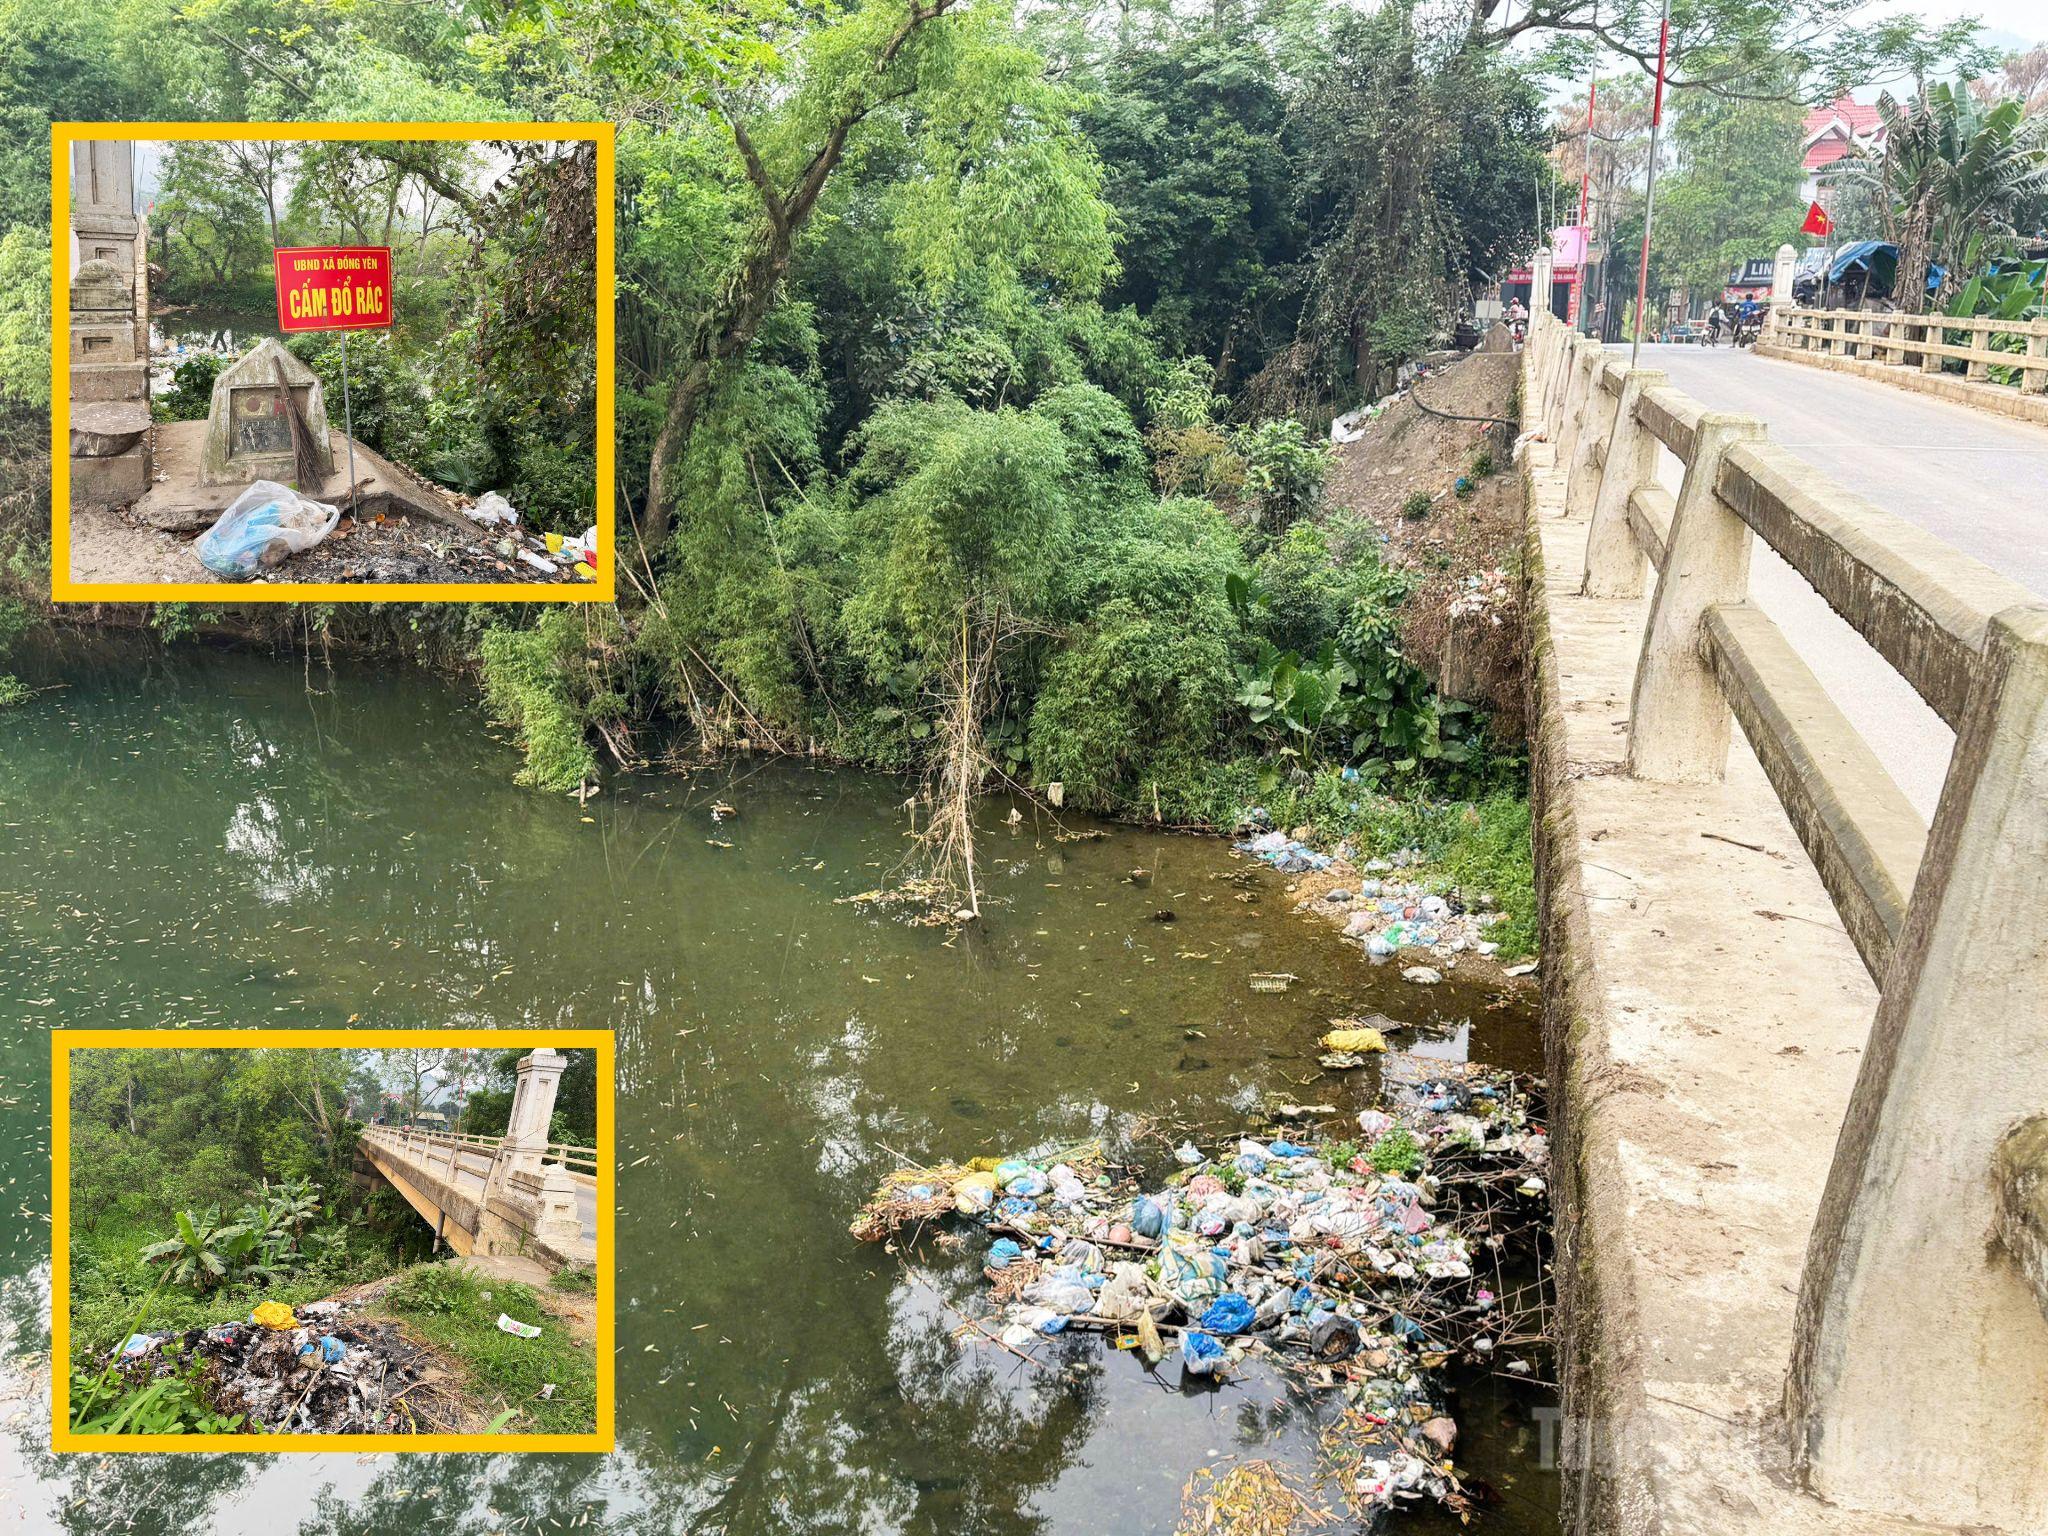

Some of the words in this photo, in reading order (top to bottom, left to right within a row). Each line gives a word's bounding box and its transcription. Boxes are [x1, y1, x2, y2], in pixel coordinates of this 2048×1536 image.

[293, 259, 320, 272] UBND
[322, 256, 336, 270] XÃ
[362, 255, 378, 270] YÊN
[289, 277, 328, 319] CẤM
[331, 275, 353, 316] ĐỔ
[355, 280, 383, 315] RÁC
